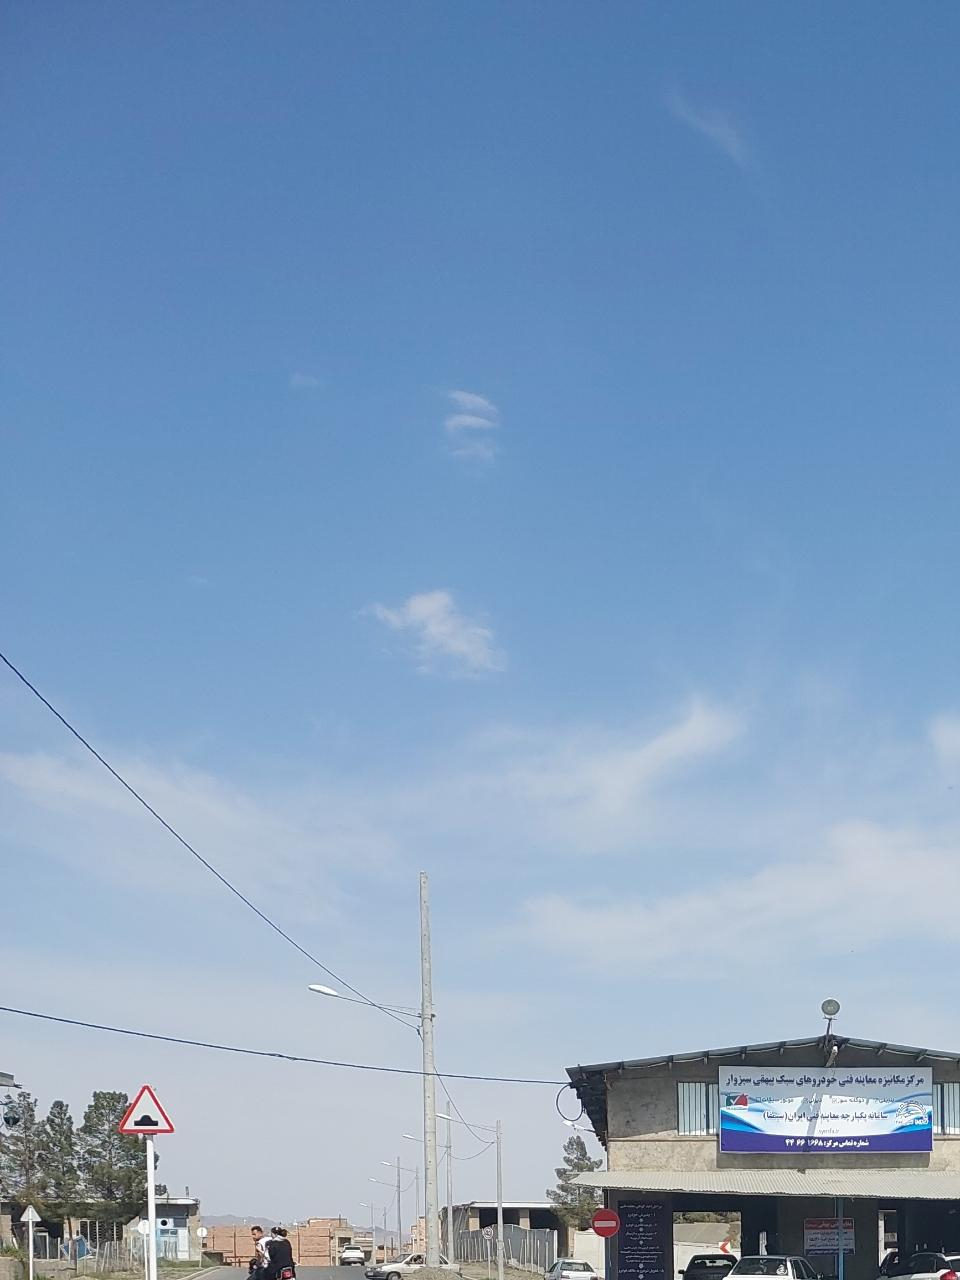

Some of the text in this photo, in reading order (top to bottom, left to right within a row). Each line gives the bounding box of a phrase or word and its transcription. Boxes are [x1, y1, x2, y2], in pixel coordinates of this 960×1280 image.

[726, 1073, 925, 1088] مرکز مکانیزه معاینه فنی خودروهای سبک بیهقی سبزوار
